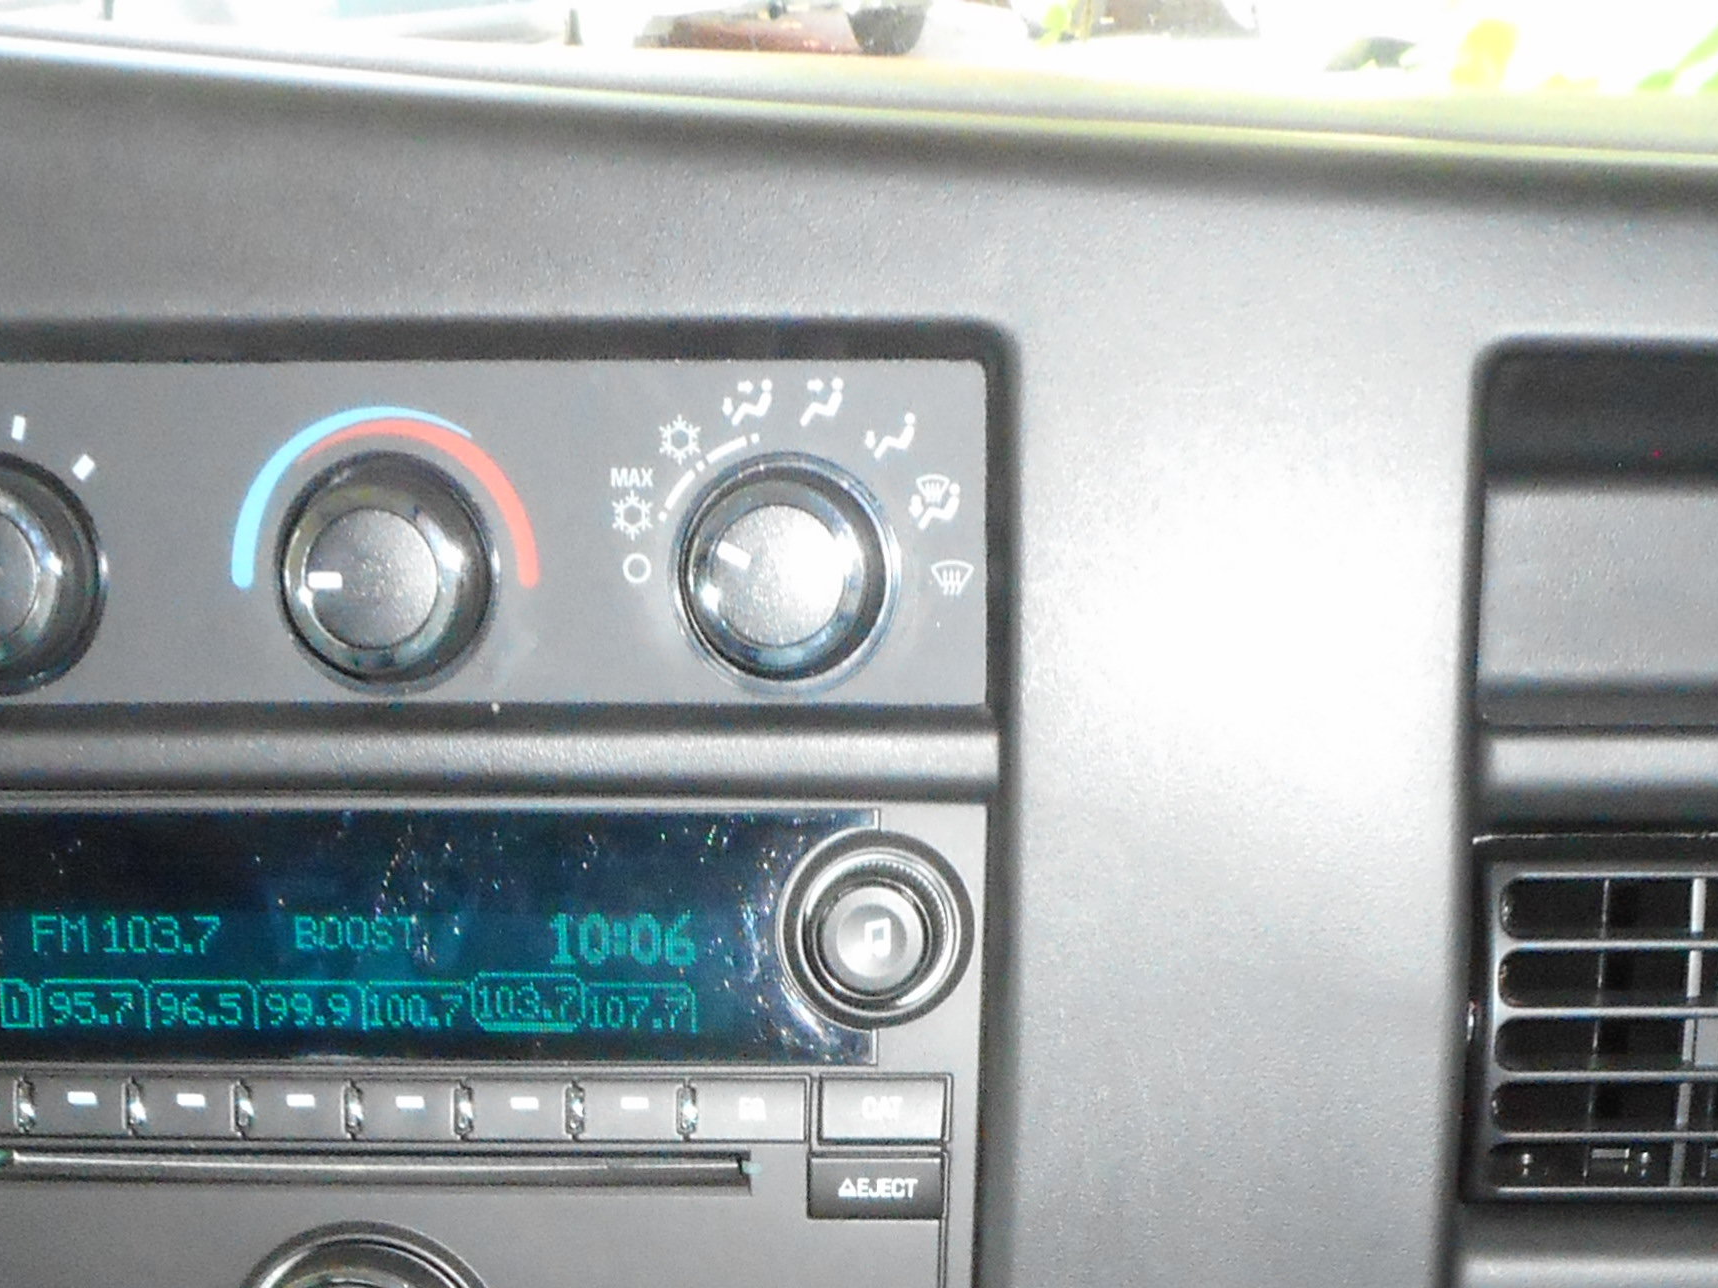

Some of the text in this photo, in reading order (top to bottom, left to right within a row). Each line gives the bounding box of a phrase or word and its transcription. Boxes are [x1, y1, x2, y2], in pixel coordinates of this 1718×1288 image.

[610, 467, 653, 488] MAX
[32, 914, 222, 954] FM 103.7
[294, 914, 415, 951] BOOST
[549, 912, 697, 967] 10:06
[49, 991, 134, 1026] 95.7
[156, 992, 243, 1026] 96.5
[264, 993, 352, 1027] 99.9
[856, 1177, 919, 1199] EJECT
